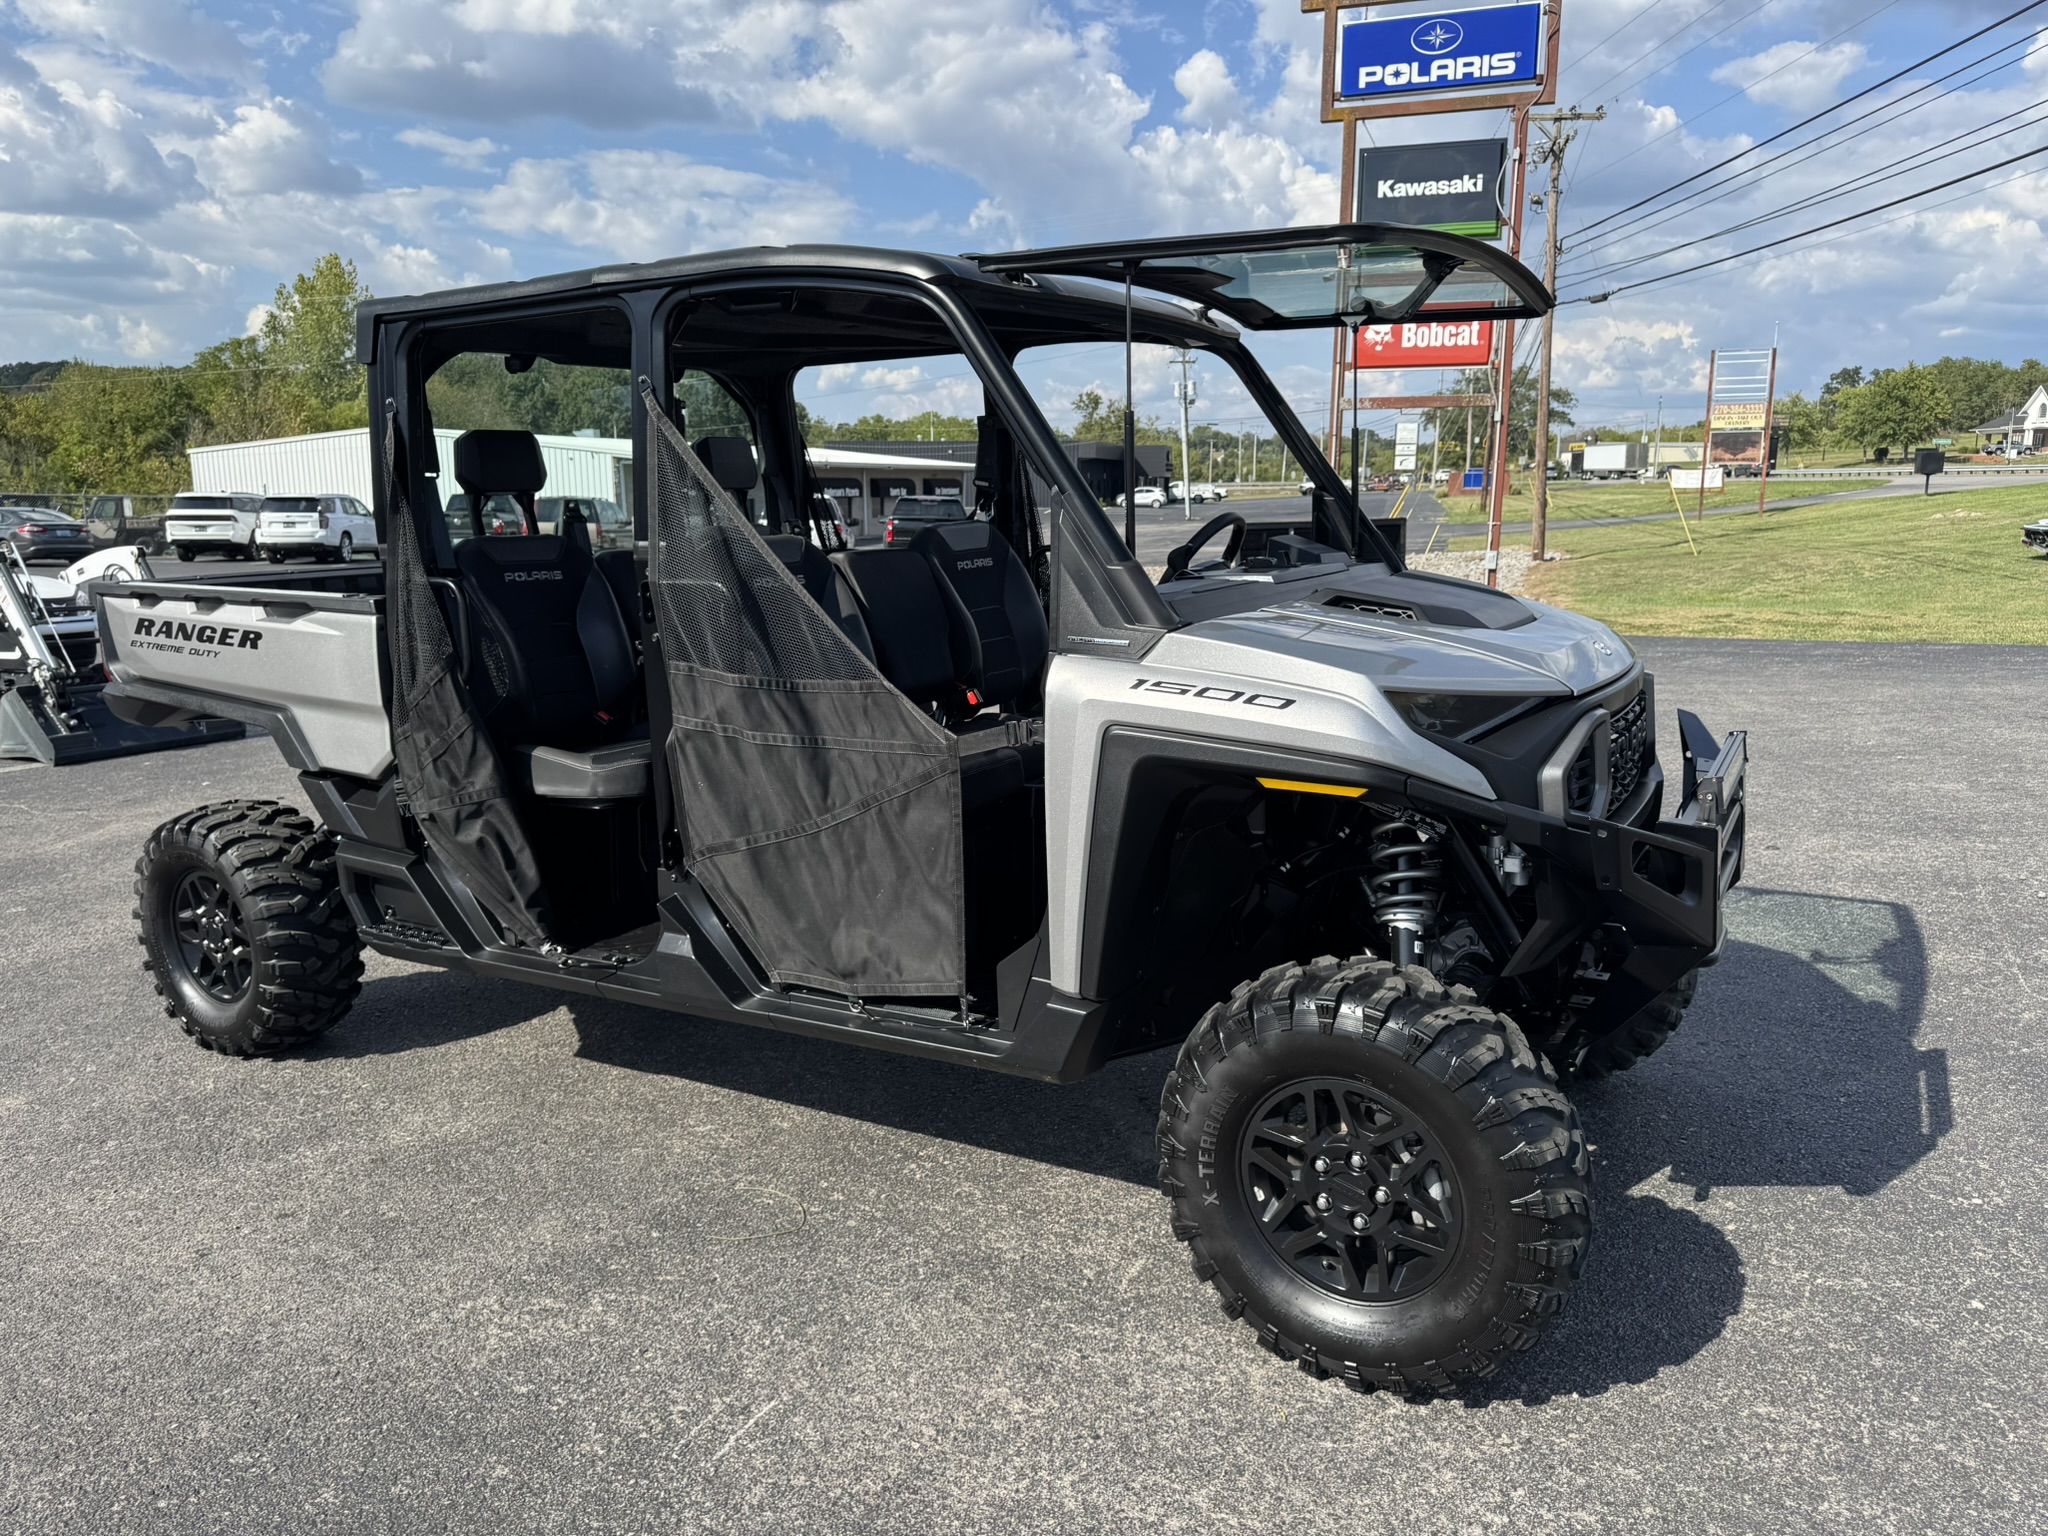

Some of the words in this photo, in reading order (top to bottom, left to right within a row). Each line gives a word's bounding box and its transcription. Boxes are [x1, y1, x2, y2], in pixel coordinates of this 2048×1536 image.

[1358, 52, 1516, 89] POLARIS
[1377, 173, 1484, 198] Kawasaki
[1401, 321, 1479, 348] Bobcat
[504, 570, 563, 583] POLARIS
[957, 557, 993, 571] POLARIS
[134, 617, 263, 650] RANGER
[130, 639, 185, 654] EXTREME
[188, 647, 221, 659] DUTY
[1129, 678, 1297, 710] 1500
[1197, 1083, 1240, 1207] X-TERRAIN
